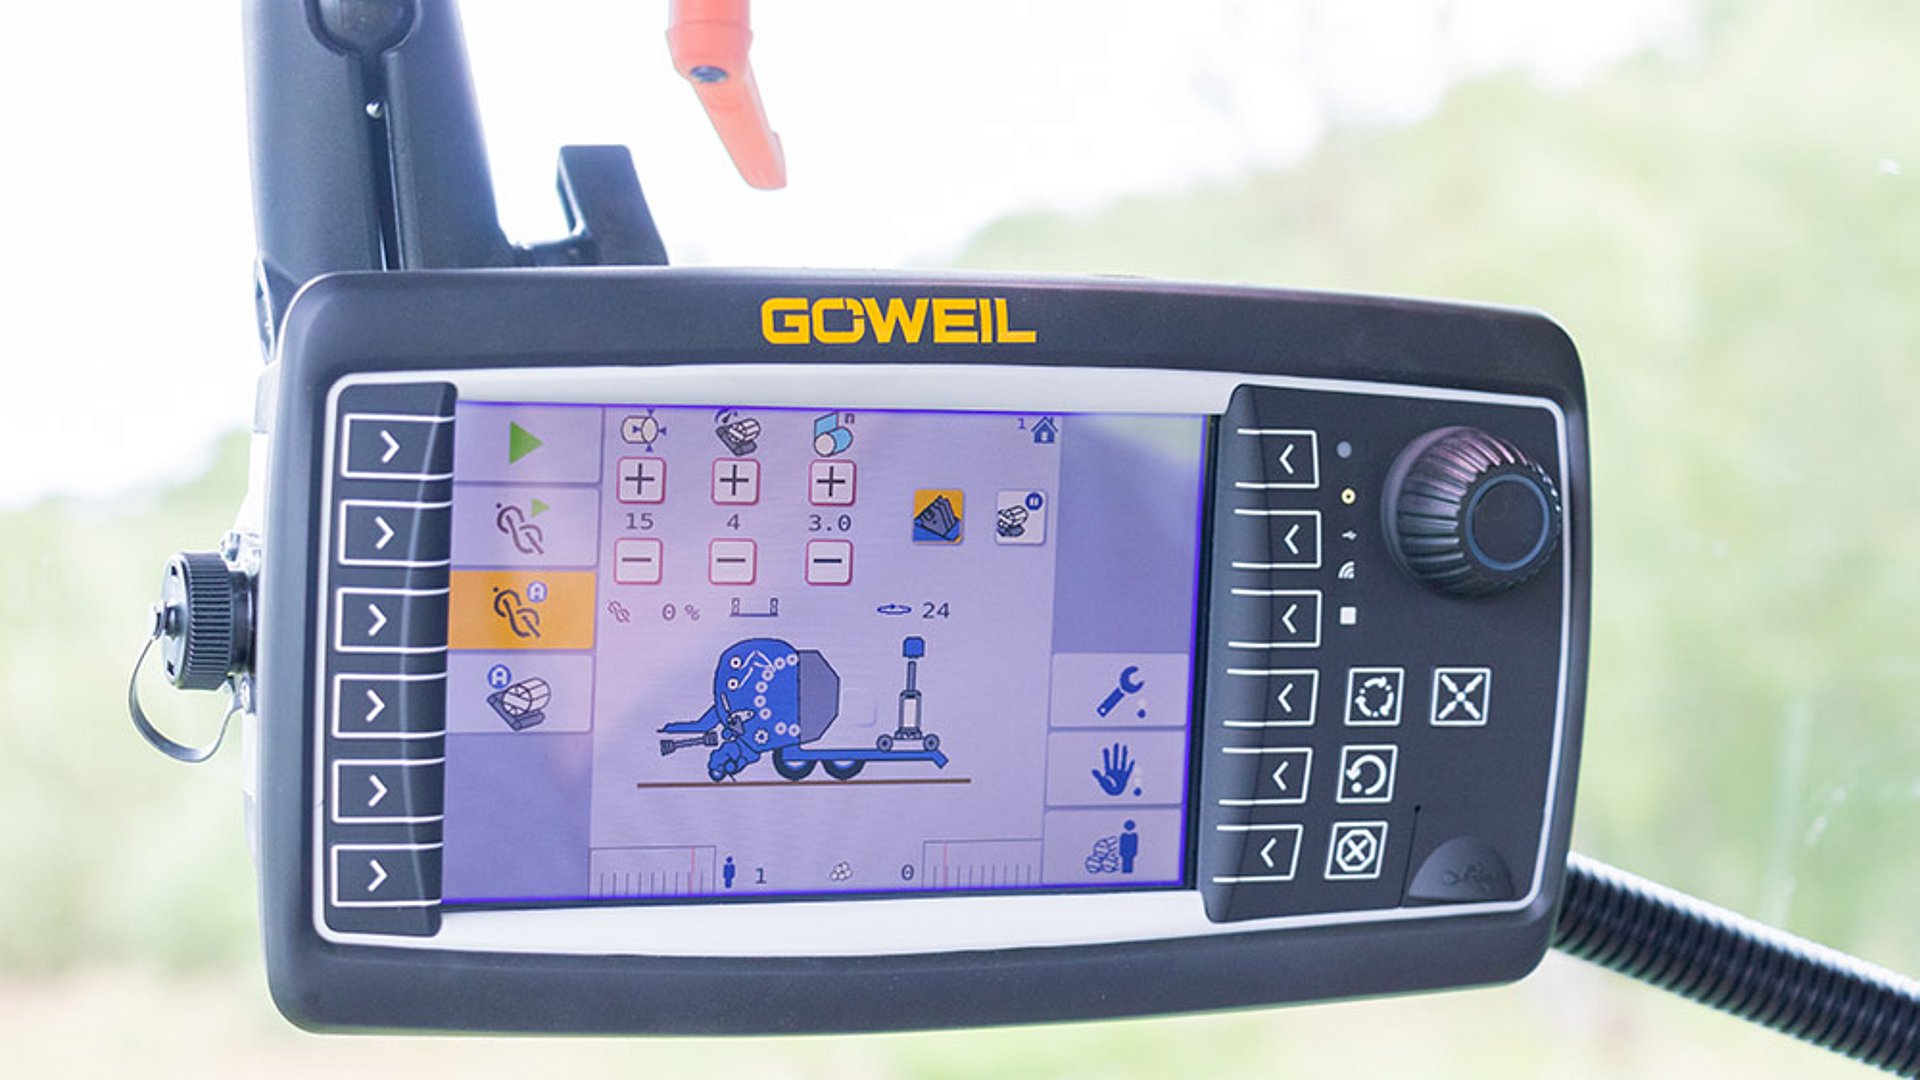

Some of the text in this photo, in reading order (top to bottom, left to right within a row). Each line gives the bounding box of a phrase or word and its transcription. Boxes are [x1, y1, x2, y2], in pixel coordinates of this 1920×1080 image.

[1017, 417, 1026, 429] 1
[625, 512, 654, 530] 15
[726, 513, 741, 530] 4
[808, 514, 852, 531] 3.0
[661, 603, 700, 621] 0 %
[921, 602, 950, 619] 24
[755, 868, 767, 884] 1
[901, 864, 914, 881] 0
